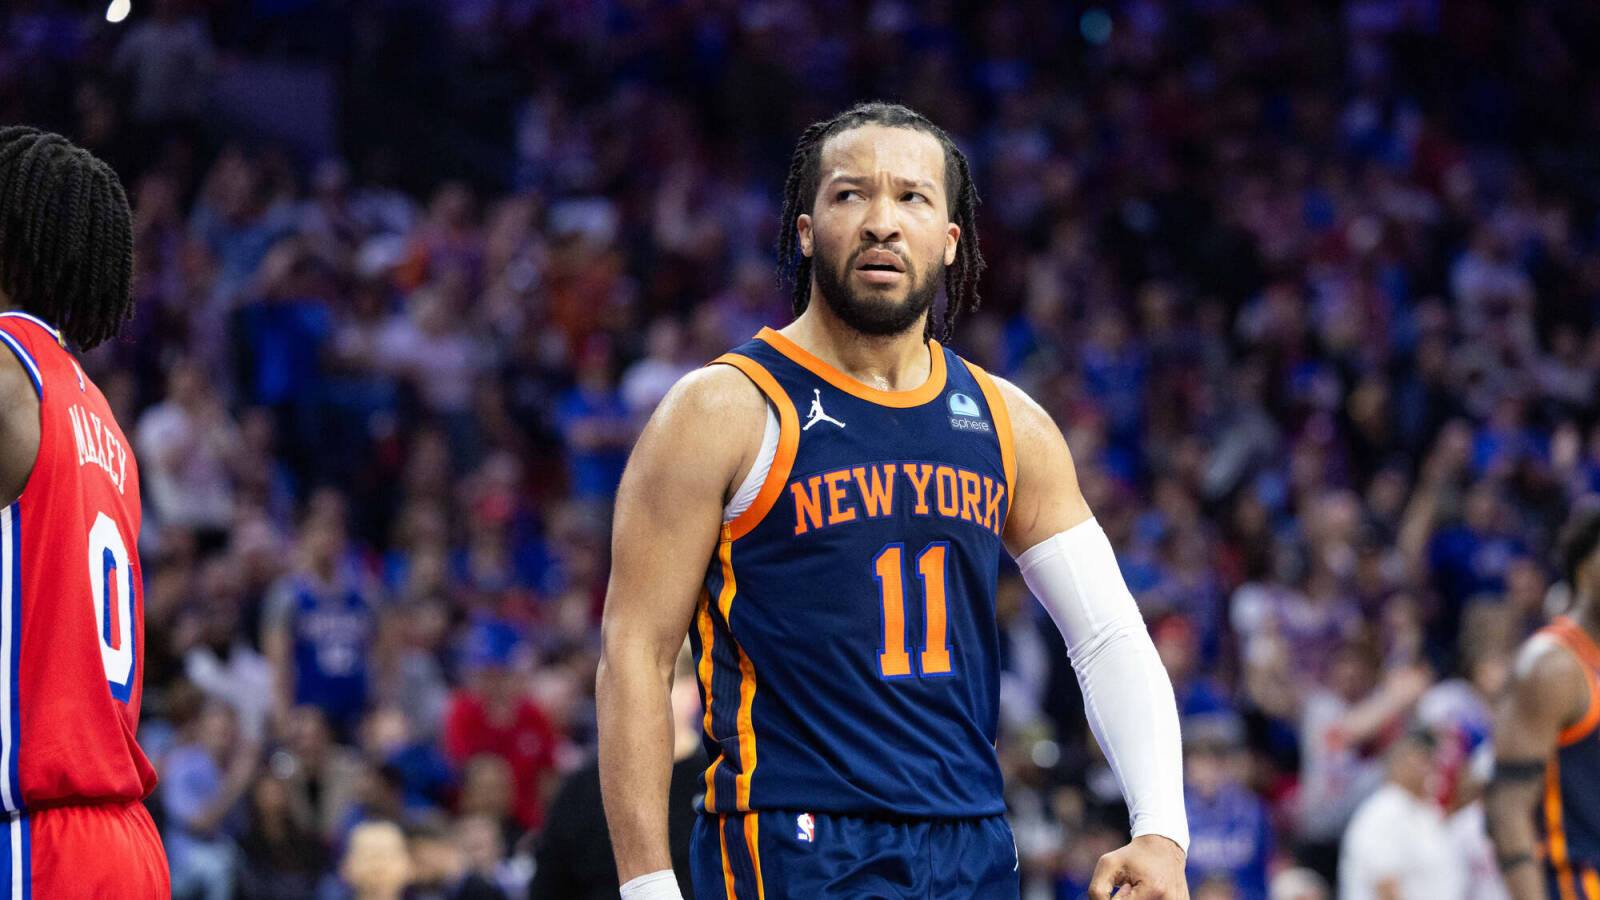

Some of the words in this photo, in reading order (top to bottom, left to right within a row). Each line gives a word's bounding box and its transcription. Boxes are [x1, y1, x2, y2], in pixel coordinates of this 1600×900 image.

[68, 404, 128, 495] MAXEY
[951, 417, 990, 432] sphere
[789, 463, 897, 537] NEW
[903, 463, 1006, 537] YORK
[88, 510, 136, 705] 0
[872, 541, 957, 681] 11
